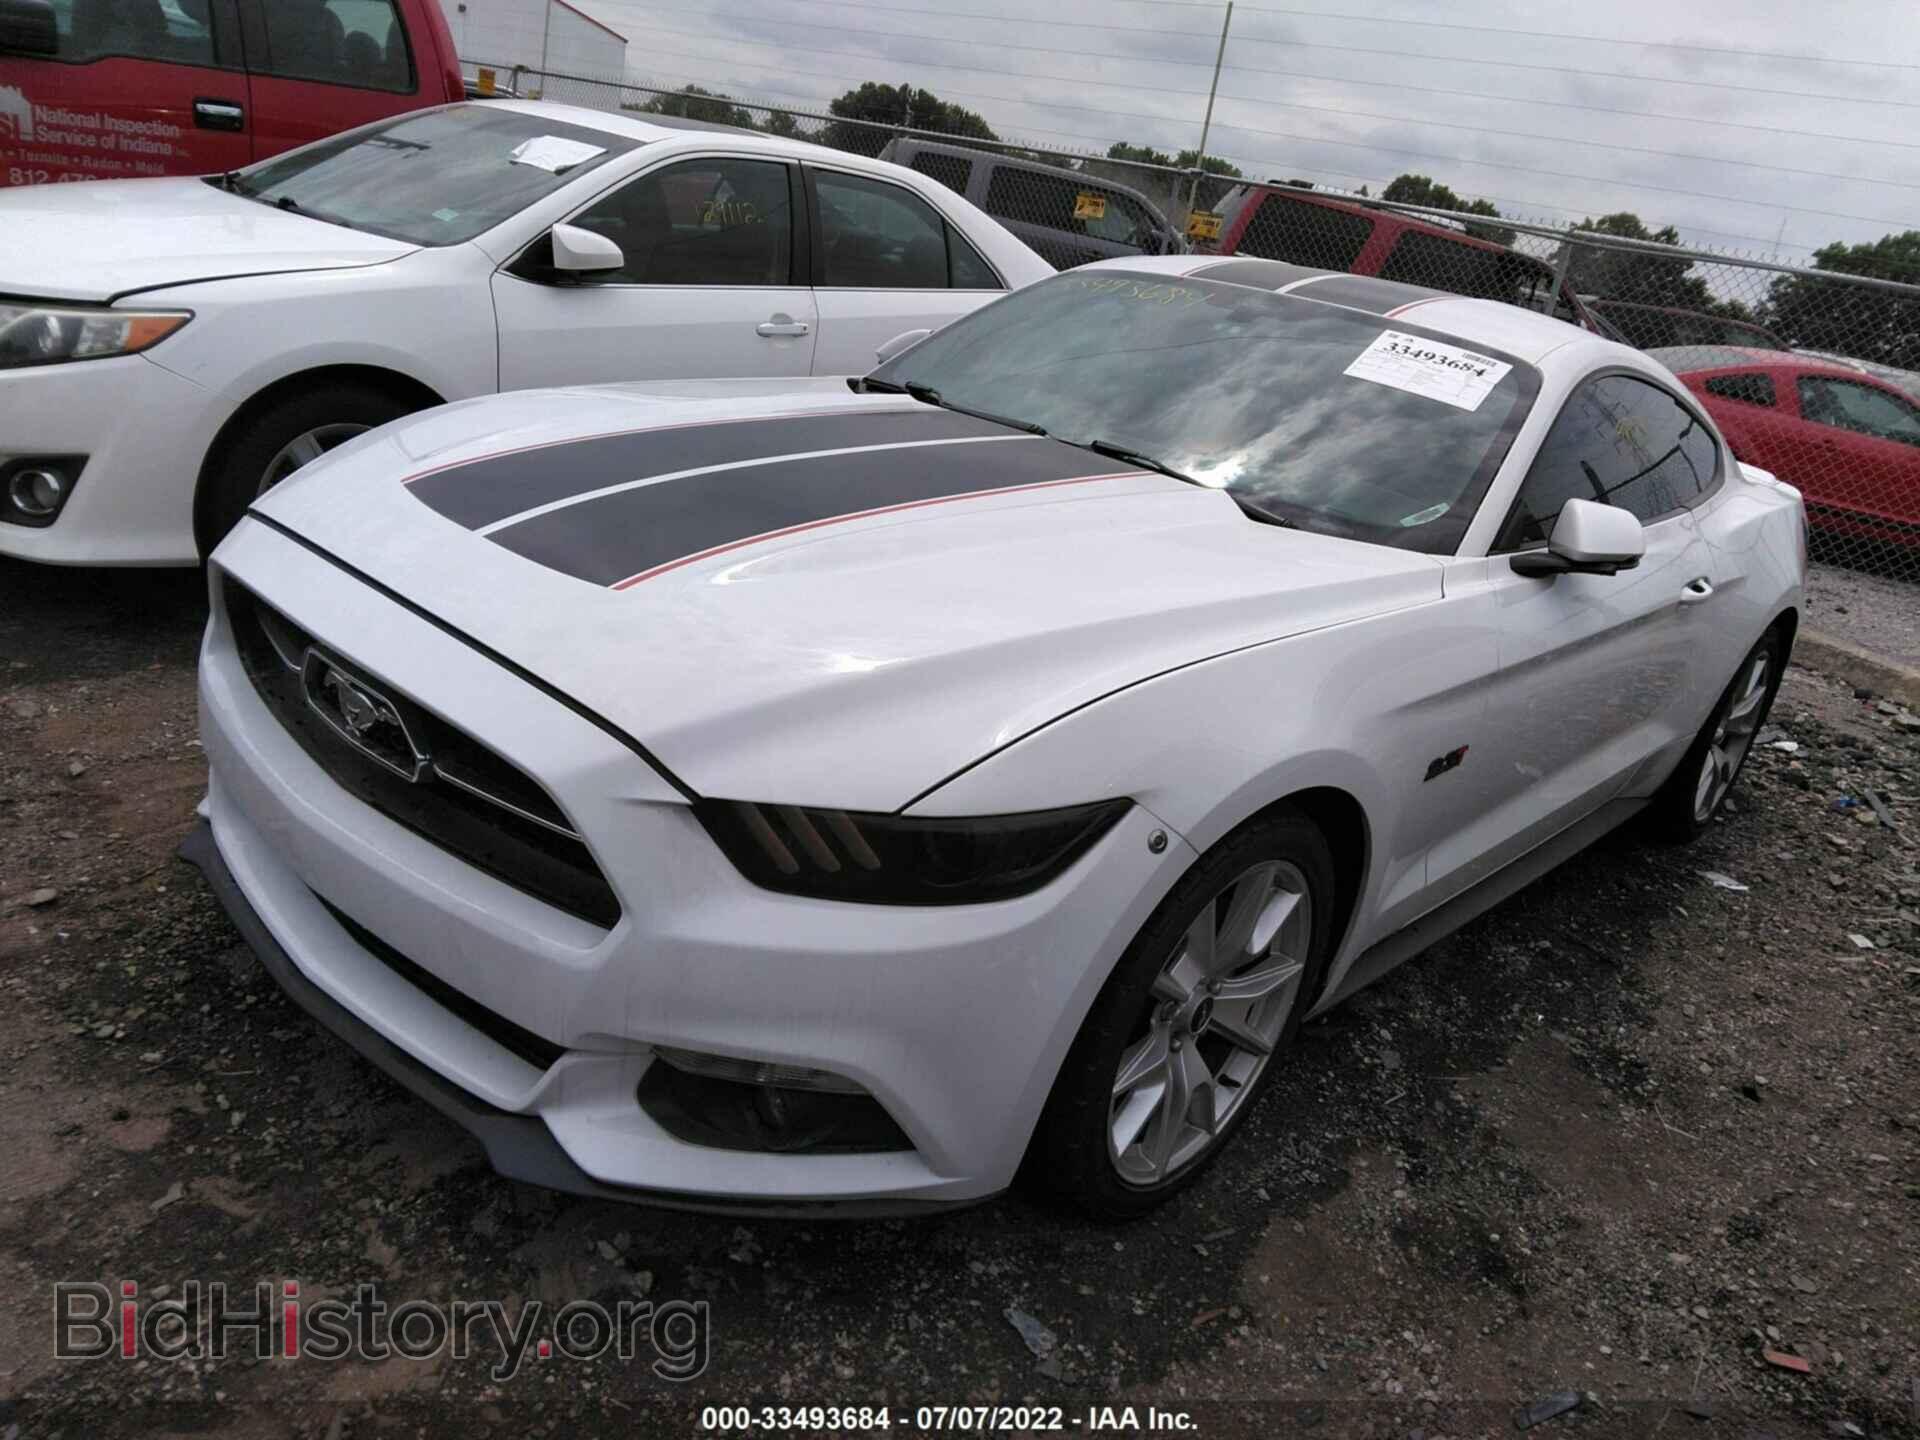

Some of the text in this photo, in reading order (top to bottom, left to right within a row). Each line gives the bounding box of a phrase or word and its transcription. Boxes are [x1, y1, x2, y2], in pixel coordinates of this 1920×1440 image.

[34, 104, 101, 129] National
[104, 113, 181, 137] Inspection
[36, 125, 97, 147] Service
[101, 135, 115, 149] of
[119, 137, 172, 155] Indiana
[19, 148, 68, 165] Termite
[82, 155, 122, 170] Radon
[9, 167, 49, 186] 812
[1383, 342, 1487, 378] 33493684
